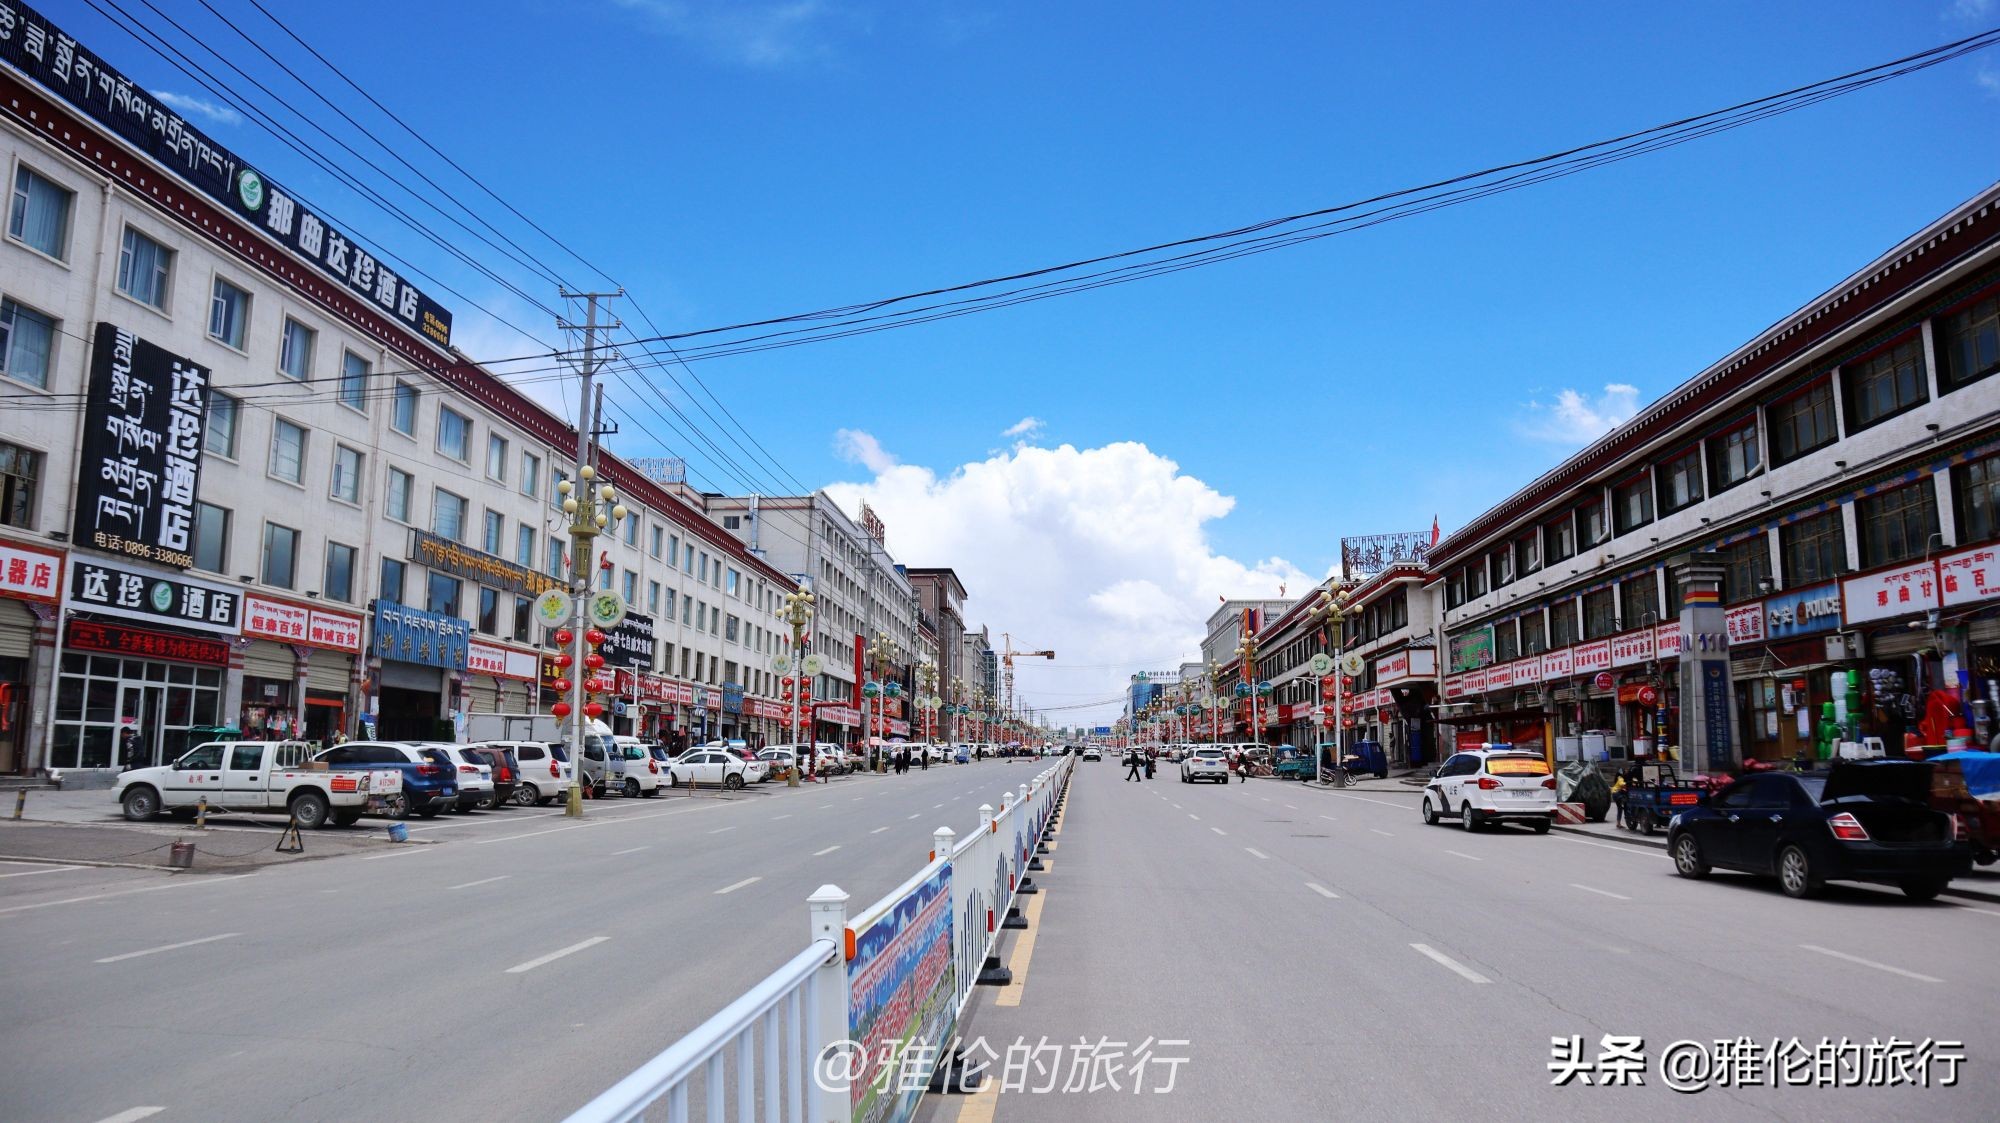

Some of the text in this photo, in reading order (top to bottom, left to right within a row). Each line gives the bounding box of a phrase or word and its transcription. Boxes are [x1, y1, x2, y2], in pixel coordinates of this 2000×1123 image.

[266, 188, 418, 322] 那曲达珍酒店
[157, 361, 206, 552] 达珍酒店
[0, 558, 51, 589] 器店
[81, 565, 232, 623] 达珍 酒店
[1805, 596, 1842, 619] POLICE
[312, 626, 357, 645] 精诚百货
